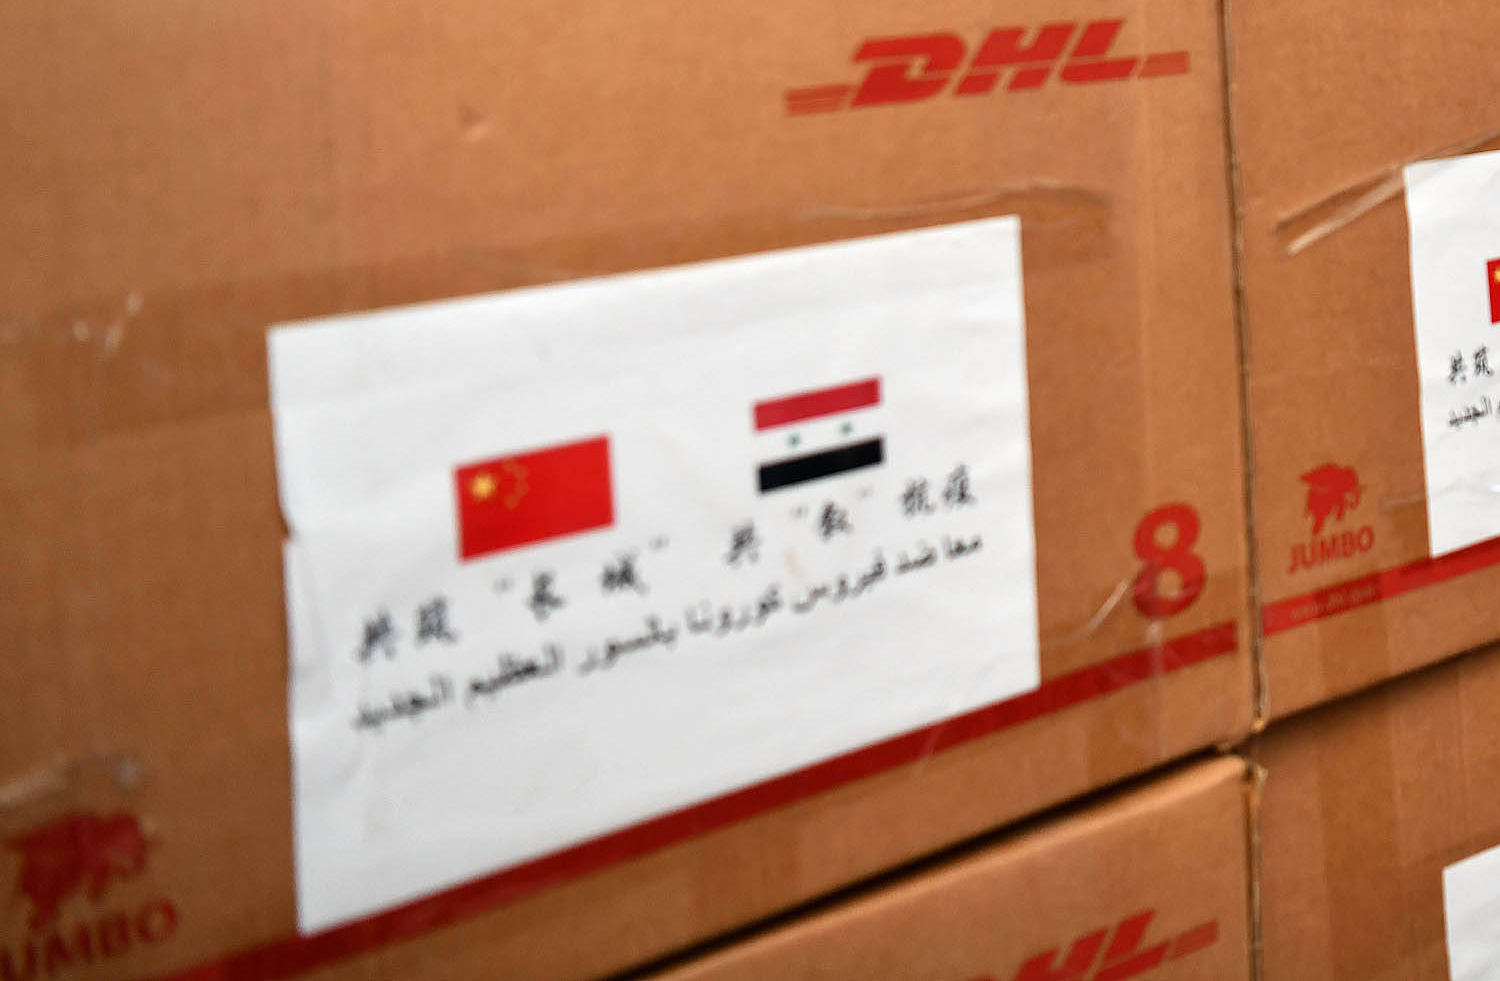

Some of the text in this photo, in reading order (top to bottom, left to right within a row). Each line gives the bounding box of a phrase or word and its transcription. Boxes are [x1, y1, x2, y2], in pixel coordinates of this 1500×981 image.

[850, 19, 1138, 109] DHL
[1132, 503, 1205, 618] 8
[1287, 525, 1374, 575] JUMBO
[0, 899, 179, 981] UMBO
